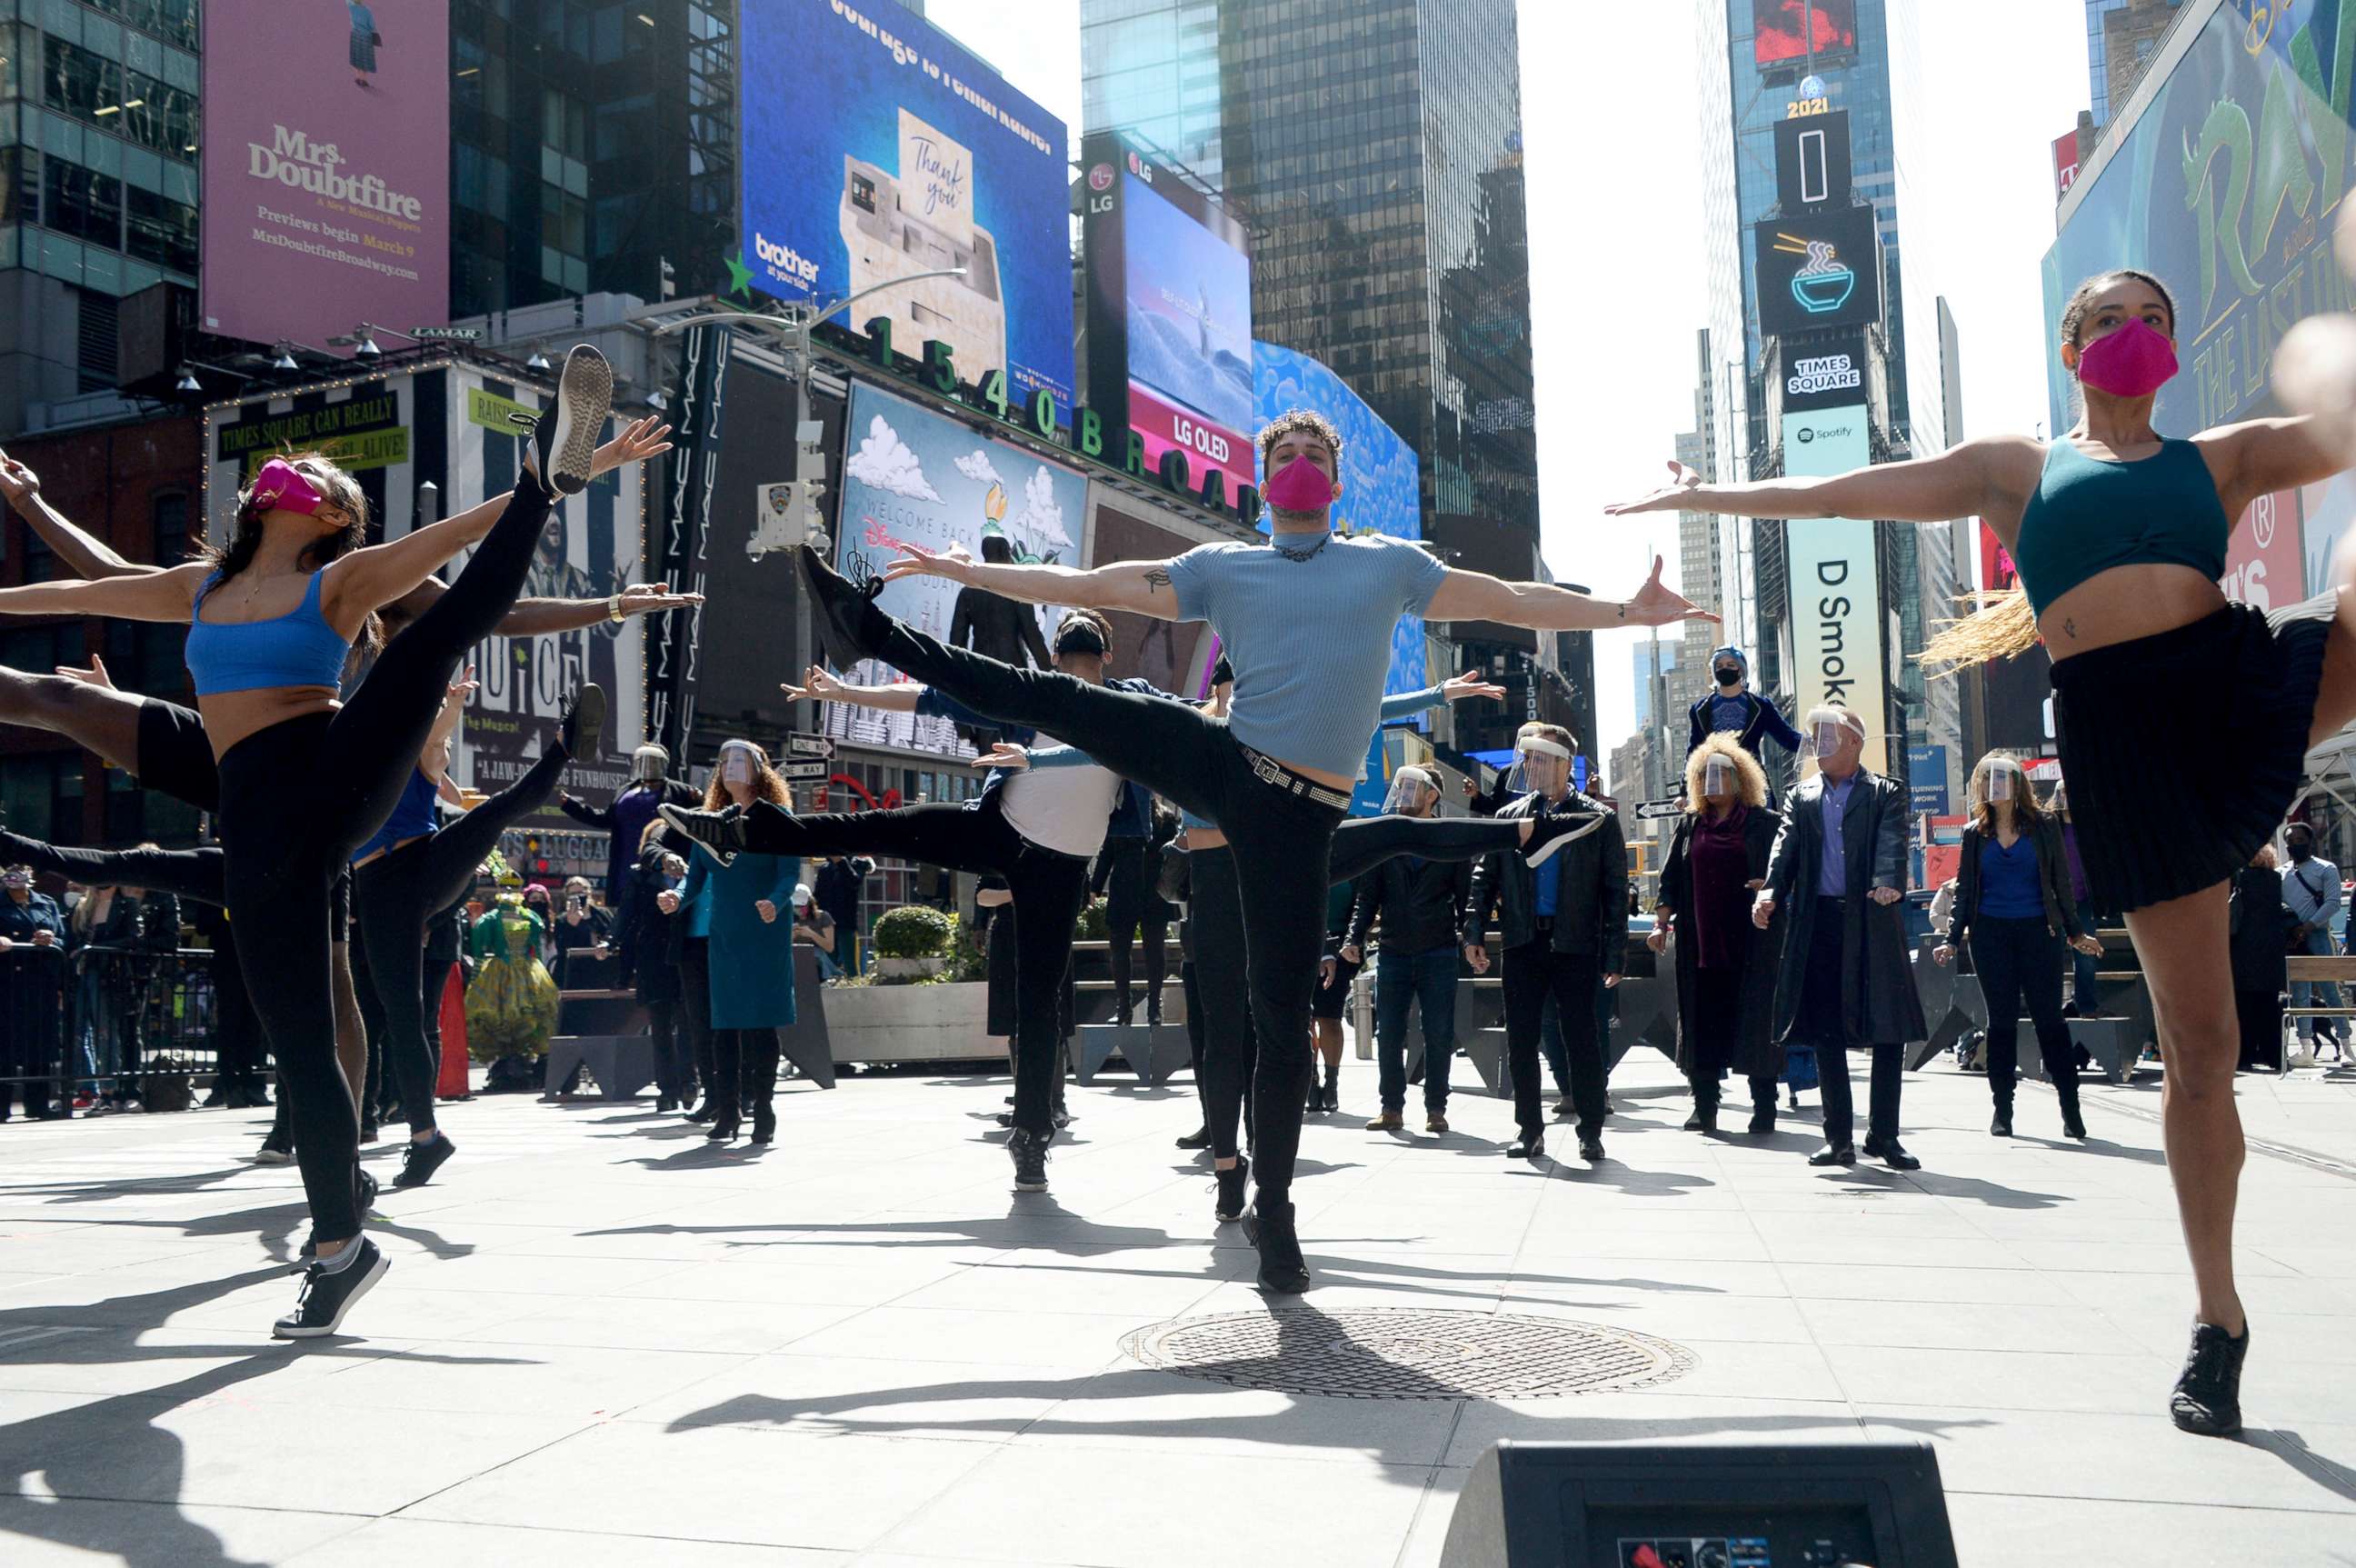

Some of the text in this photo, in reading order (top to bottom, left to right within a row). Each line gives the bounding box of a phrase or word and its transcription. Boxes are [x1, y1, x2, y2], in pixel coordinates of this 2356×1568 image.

[1787, 97, 1828, 120] 2021
[274, 124, 346, 166] Mrs.
[912, 136, 964, 189] Thank
[1139, 159, 1152, 184] LG
[247, 142, 422, 221] Doubtfire
[924, 181, 960, 215] you
[1091, 195, 1113, 214] LG
[257, 205, 414, 258] Previews begin March 9
[253, 227, 419, 282] MrsDoubtfireBroadway.com
[755, 232, 819, 284] brother
[414, 327, 475, 339] LAMAR
[1795, 355, 1851, 376] TIMES
[1788, 369, 1861, 394] SQUARE
[222, 396, 393, 452] TIMES SQUARE CAN REALLY
[1173, 414, 1230, 464] LG OLED
[1816, 426, 1852, 440] Spotify
[867, 498, 975, 546] WELCOME BACK
[1817, 560, 1849, 587] D
[1526, 674, 1537, 722] 1500
[796, 740, 829, 753] ONE WAY
[780, 764, 822, 775] ONE WAY
[1642, 805, 1677, 815] ONE WA
